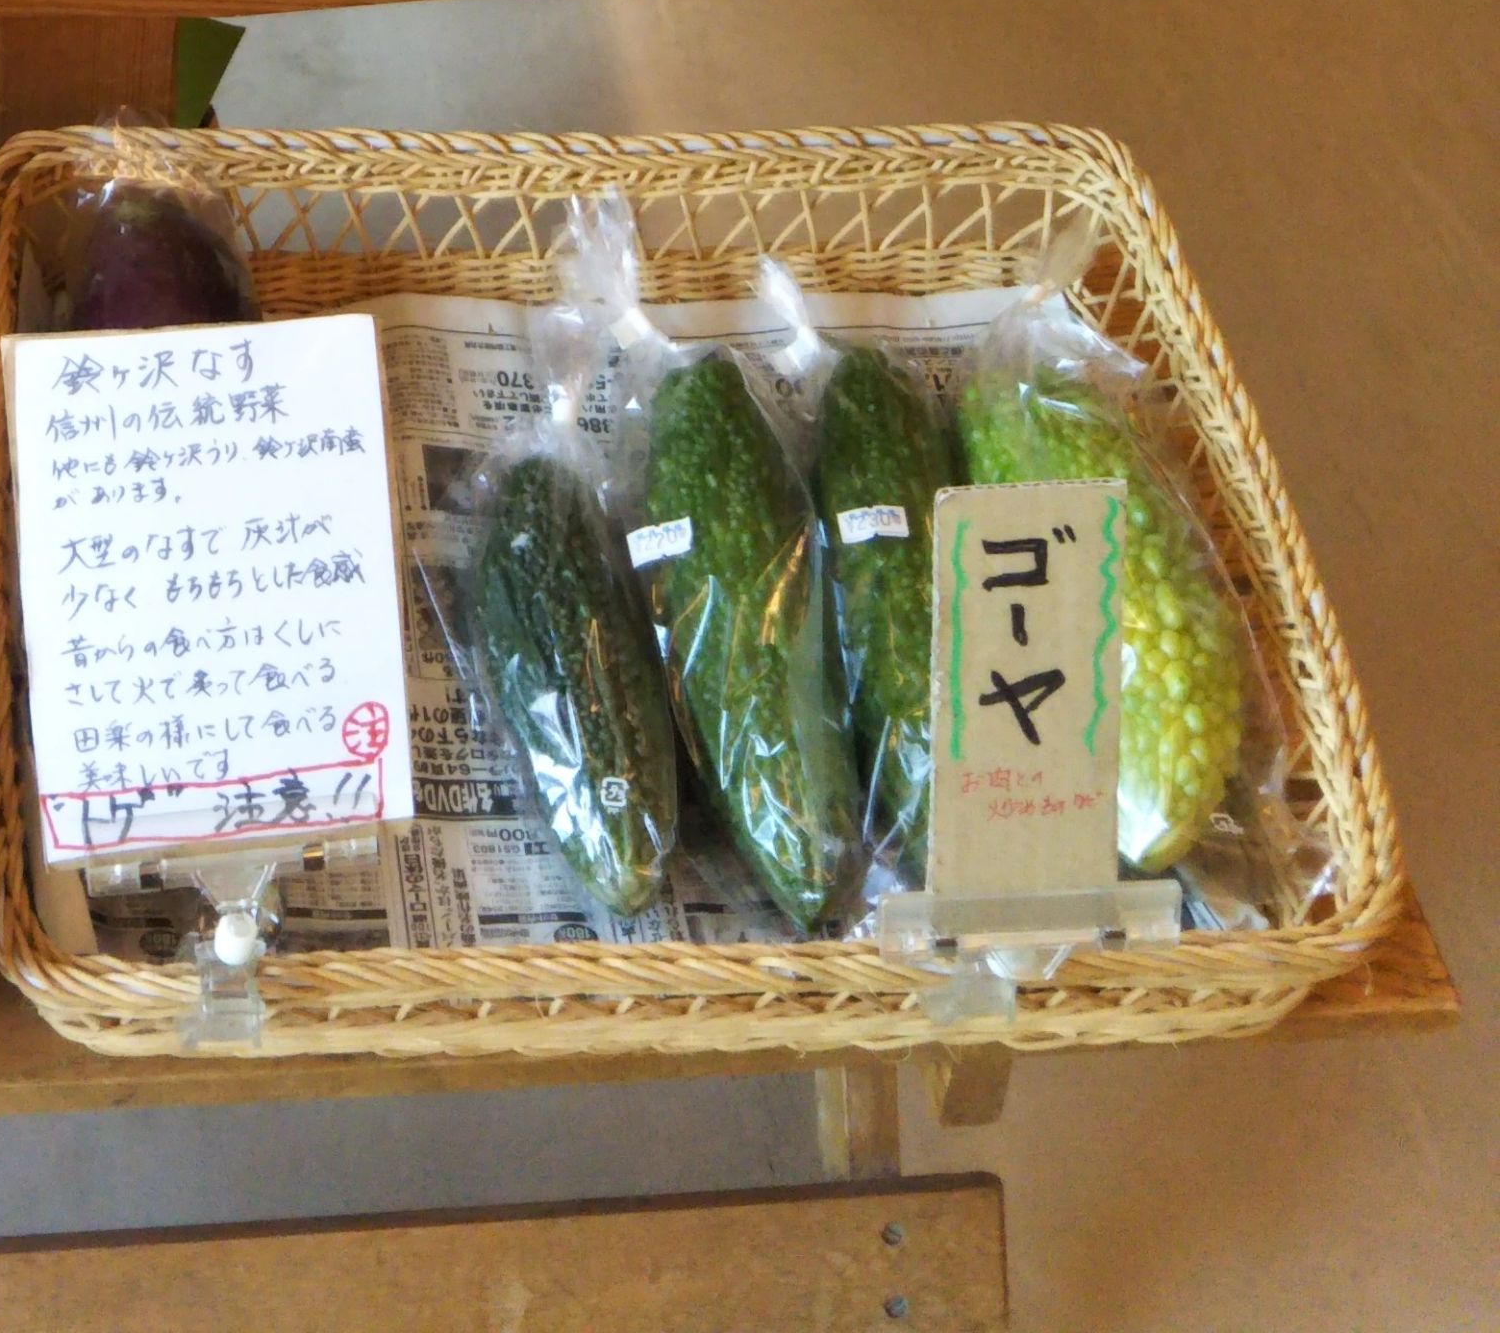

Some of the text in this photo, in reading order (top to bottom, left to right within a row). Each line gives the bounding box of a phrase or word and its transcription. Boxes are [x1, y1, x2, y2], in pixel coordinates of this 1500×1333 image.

[46, 383, 290, 442] 信州の伝統野菜
[977, 524, 1077, 746] ゴーヤ
